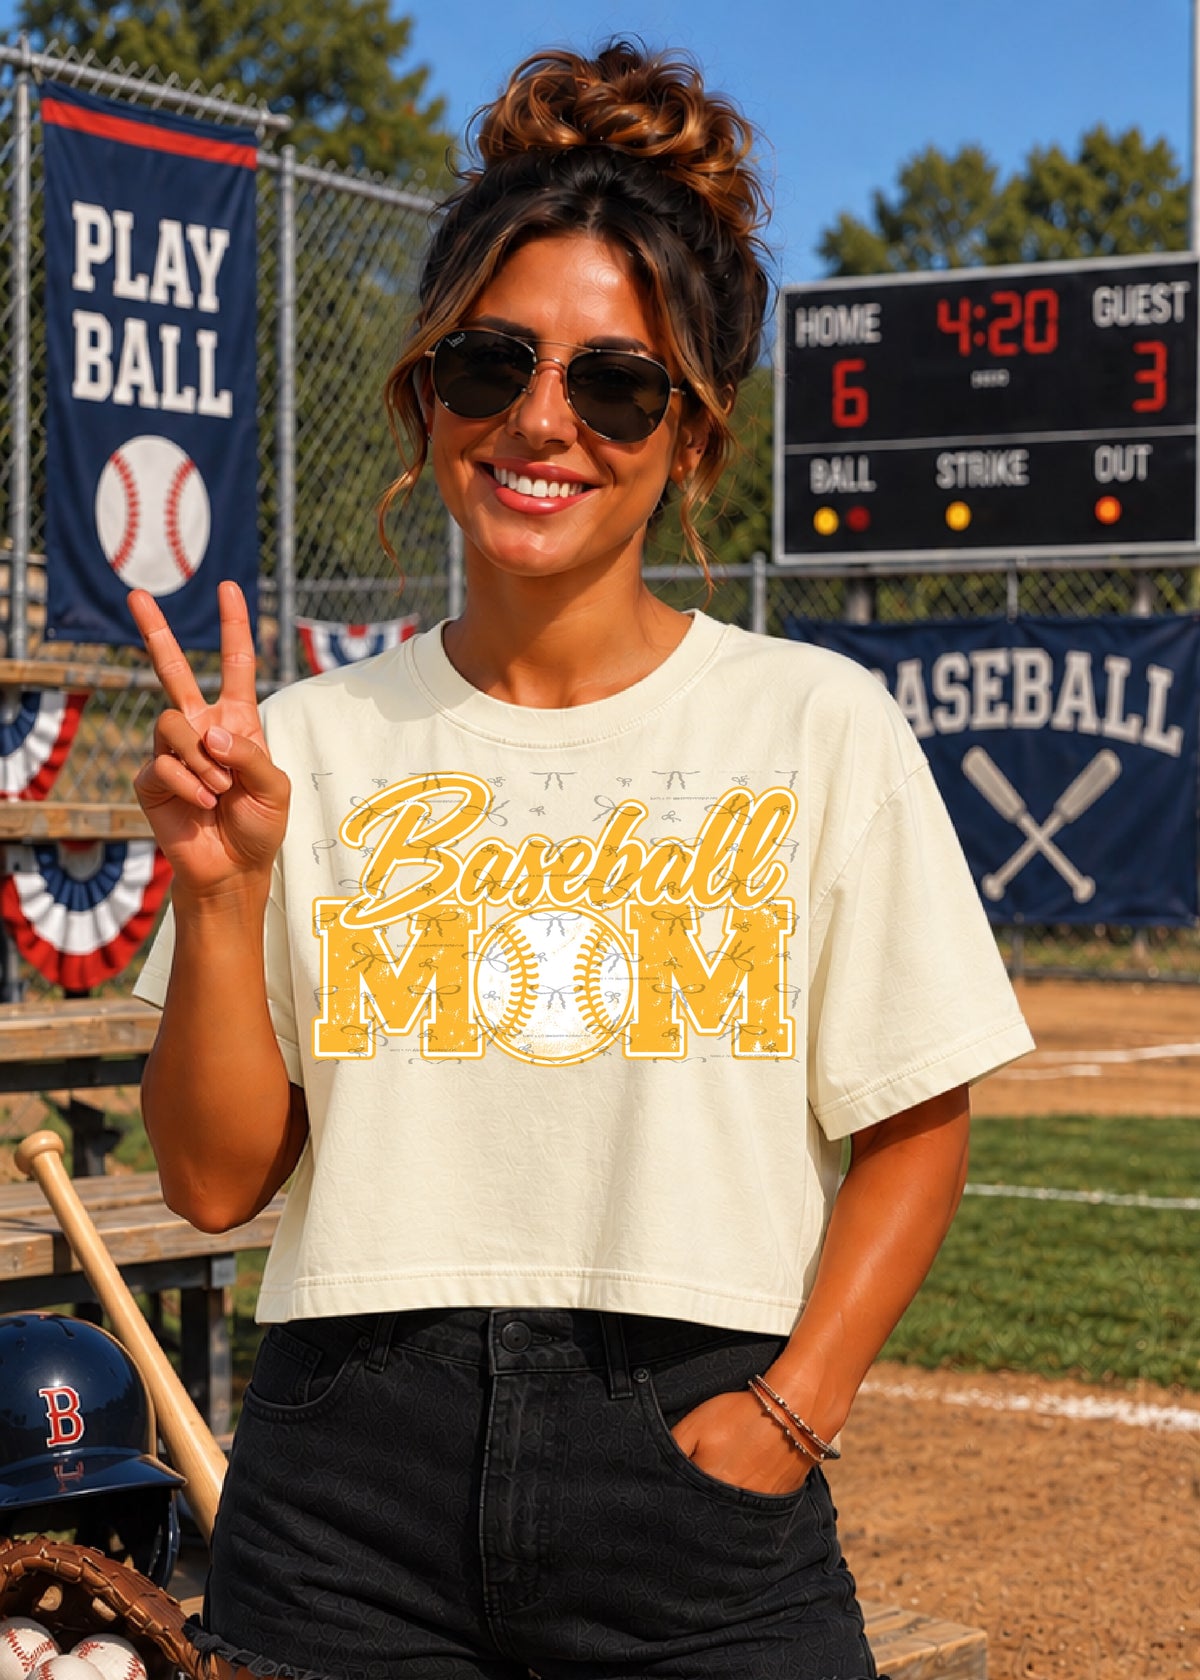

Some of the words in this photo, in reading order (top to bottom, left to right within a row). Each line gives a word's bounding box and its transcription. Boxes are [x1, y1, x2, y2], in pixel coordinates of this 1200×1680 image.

[72, 200, 230, 313] PLAY
[795, 303, 882, 347] HOME
[937, 289, 1059, 357] 4:20
[1092, 281, 1191, 328] GUEST
[72, 309, 233, 419] BALL
[832, 358, 869, 428] 6
[1132, 341, 1168, 412] 3
[810, 455, 877, 494] BALL
[936, 449, 1030, 489] STRIKE
[1094, 444, 1153, 483] OUT
[870, 647, 1184, 757] ASEBALL
[339, 771, 798, 928] Baseball
[311, 896, 796, 1066] MOM
[39, 1385, 85, 1448] B
